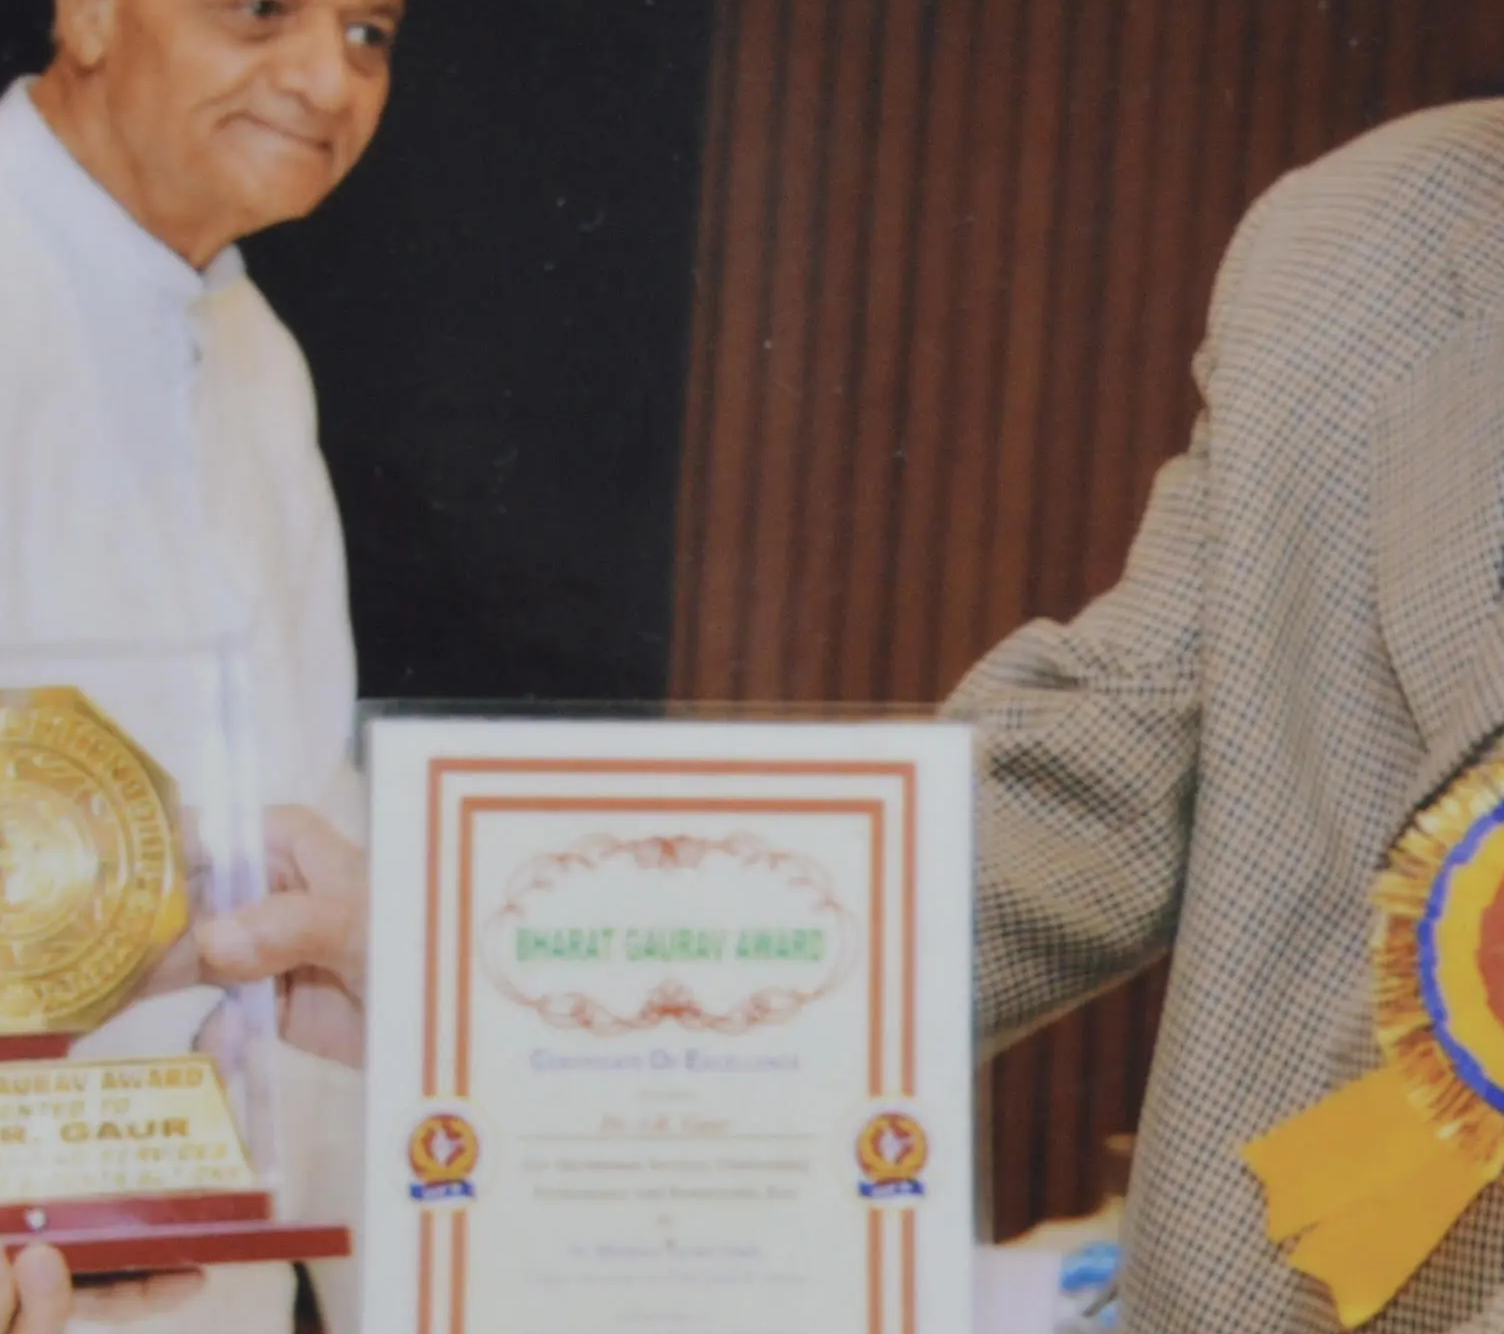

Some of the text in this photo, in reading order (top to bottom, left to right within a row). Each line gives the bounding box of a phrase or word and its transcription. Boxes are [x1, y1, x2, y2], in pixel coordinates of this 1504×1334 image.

[516, 927, 824, 961] BHARAT GAURAV AWARD
[101, 1067, 204, 1091] AWARD
[60, 1117, 190, 1144] GAUR
